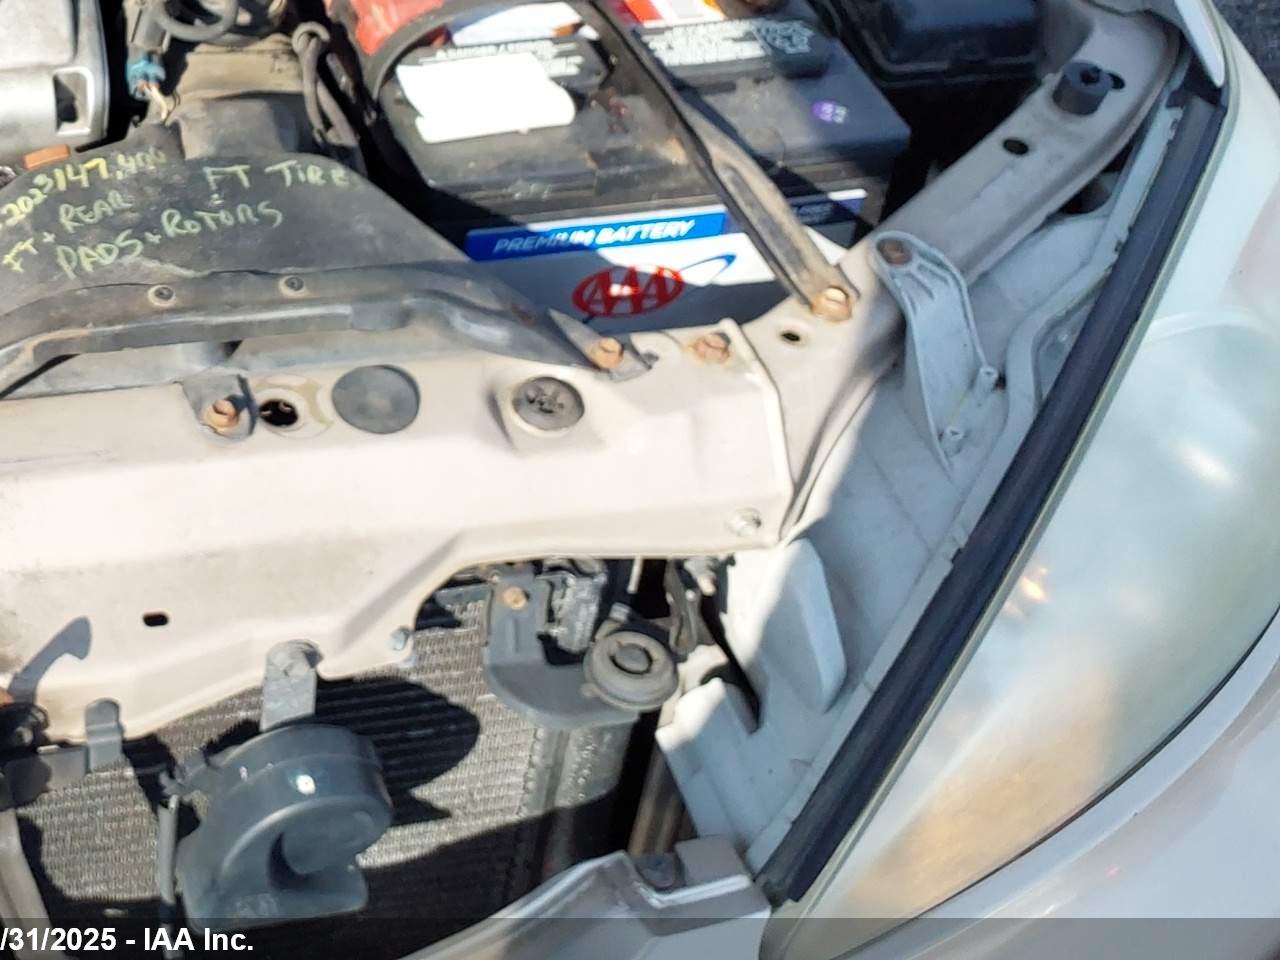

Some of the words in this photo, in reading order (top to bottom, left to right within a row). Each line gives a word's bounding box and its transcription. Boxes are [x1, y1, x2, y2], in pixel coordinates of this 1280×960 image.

[492, 227, 597, 254] PREMIUM
[595, 219, 697, 246] BATTERY
[571, 264, 685, 319] AAA
